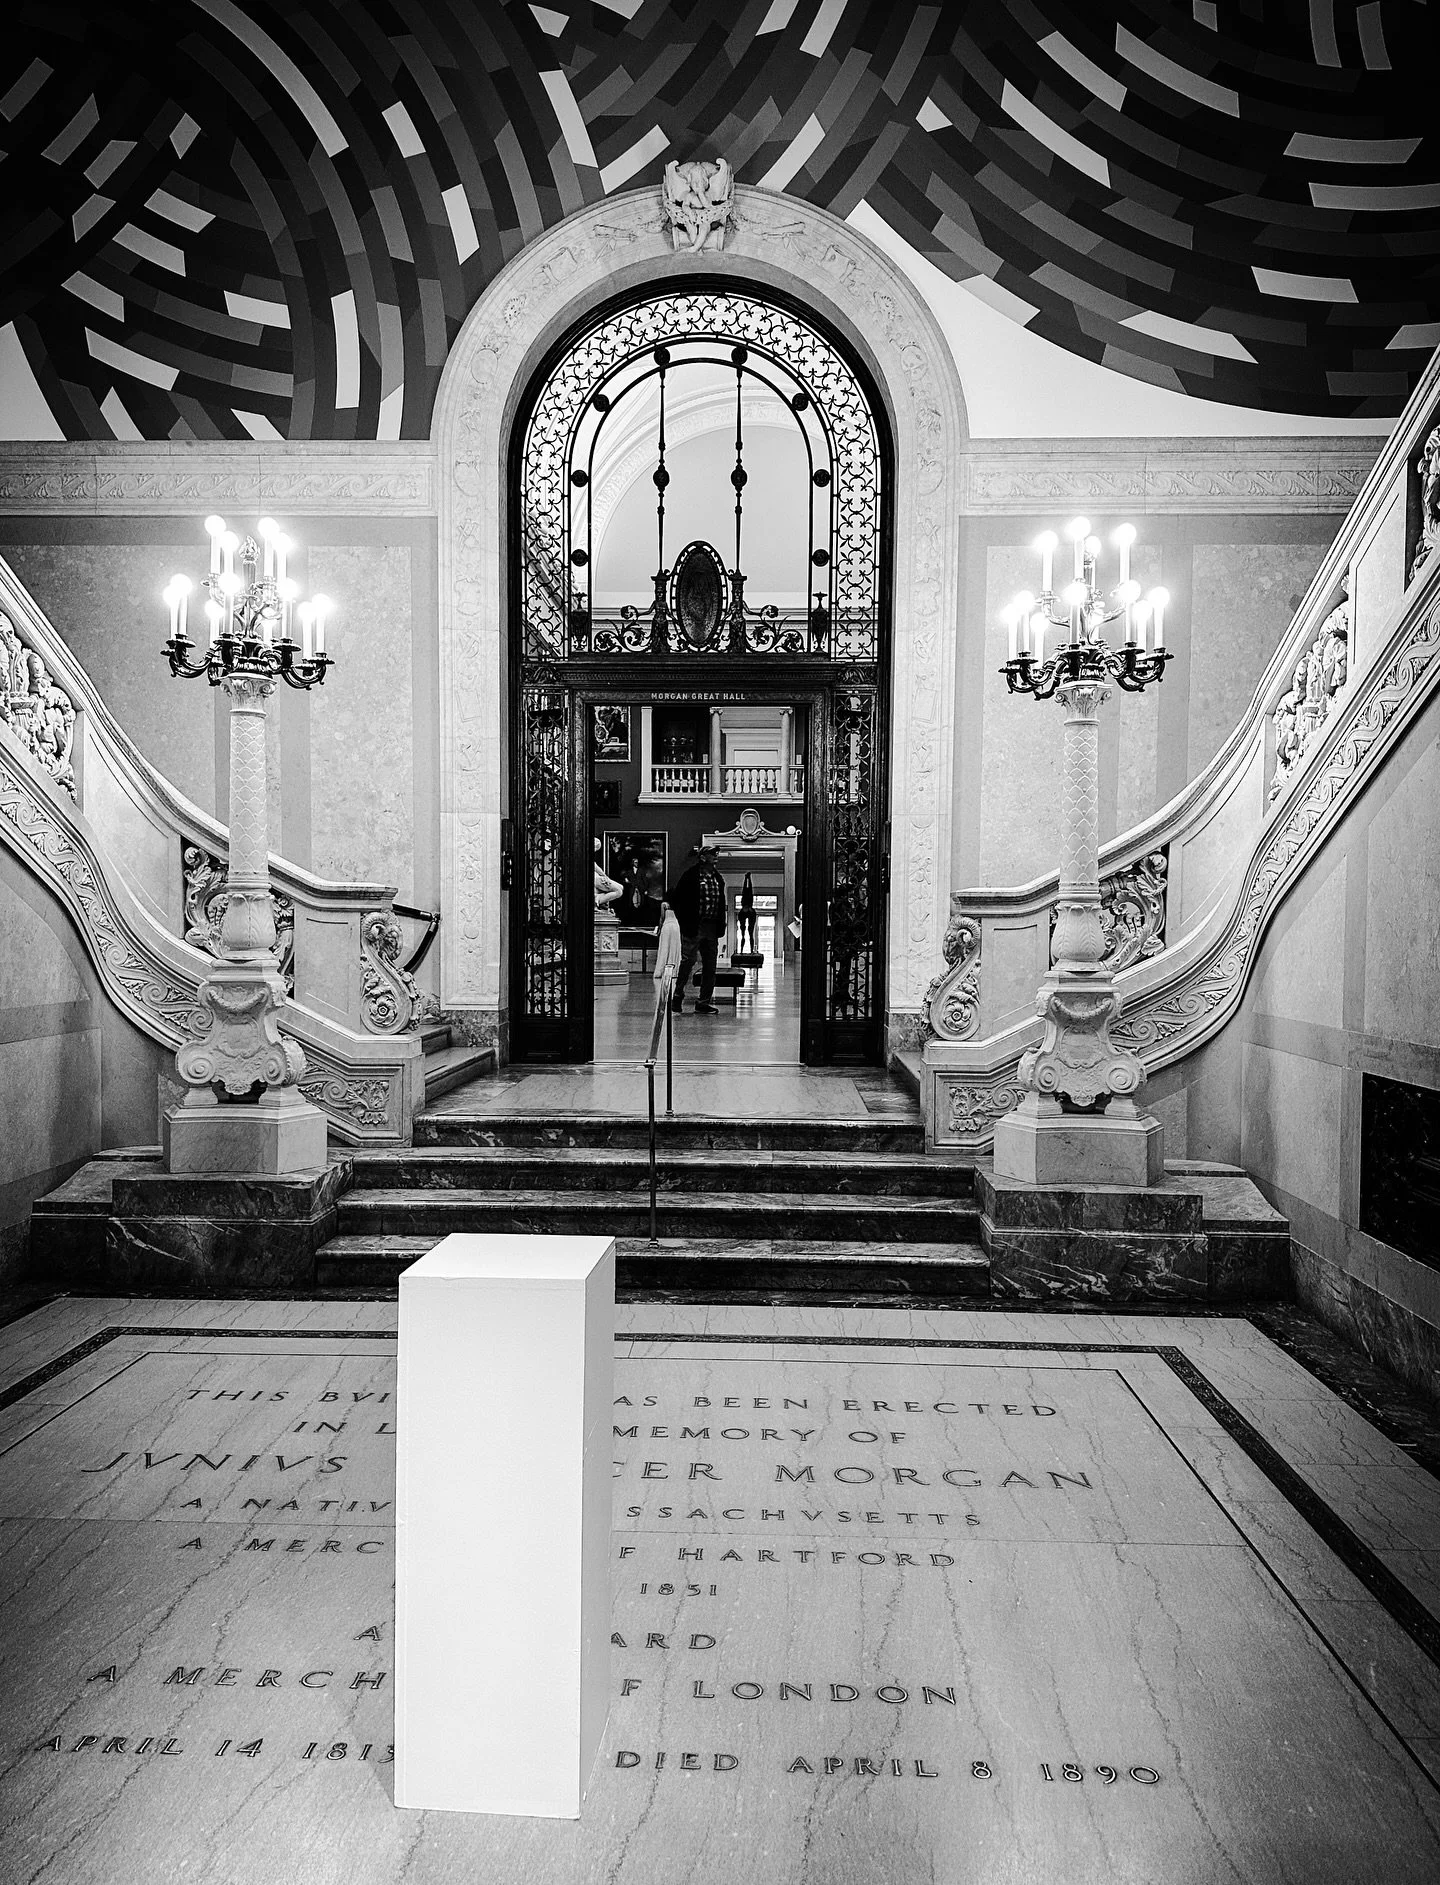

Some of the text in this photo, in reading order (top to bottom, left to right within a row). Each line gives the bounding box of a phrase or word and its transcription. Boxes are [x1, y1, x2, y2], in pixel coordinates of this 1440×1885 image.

[186, 1390, 1056, 1417] THIS BVI AS BEEN ERECTED
[293, 1421, 346, 1433] IN
[613, 1425, 815, 1442] MEMORY
[848, 1431, 906, 1443] OF
[81, 1452, 1093, 1489] JVNIVS ER MORGAN
[180, 1497, 980, 1526] A NATIV SSACHVSETTS
[179, 1537, 954, 1567] A MERC F HARTFORD
[640, 1583, 717, 1596] 1851
[611, 1632, 716, 1650] ARD
[87, 1665, 957, 1706] A MERCH F LONDON
[34, 1735, 183, 1756] APRIL
[215, 1738, 264, 1757] 14
[615, 1750, 739, 1771] DIED
[787, 1756, 938, 1778] APRIL
[971, 1761, 992, 1780] 8
[1041, 1762, 1160, 1785] 1890
